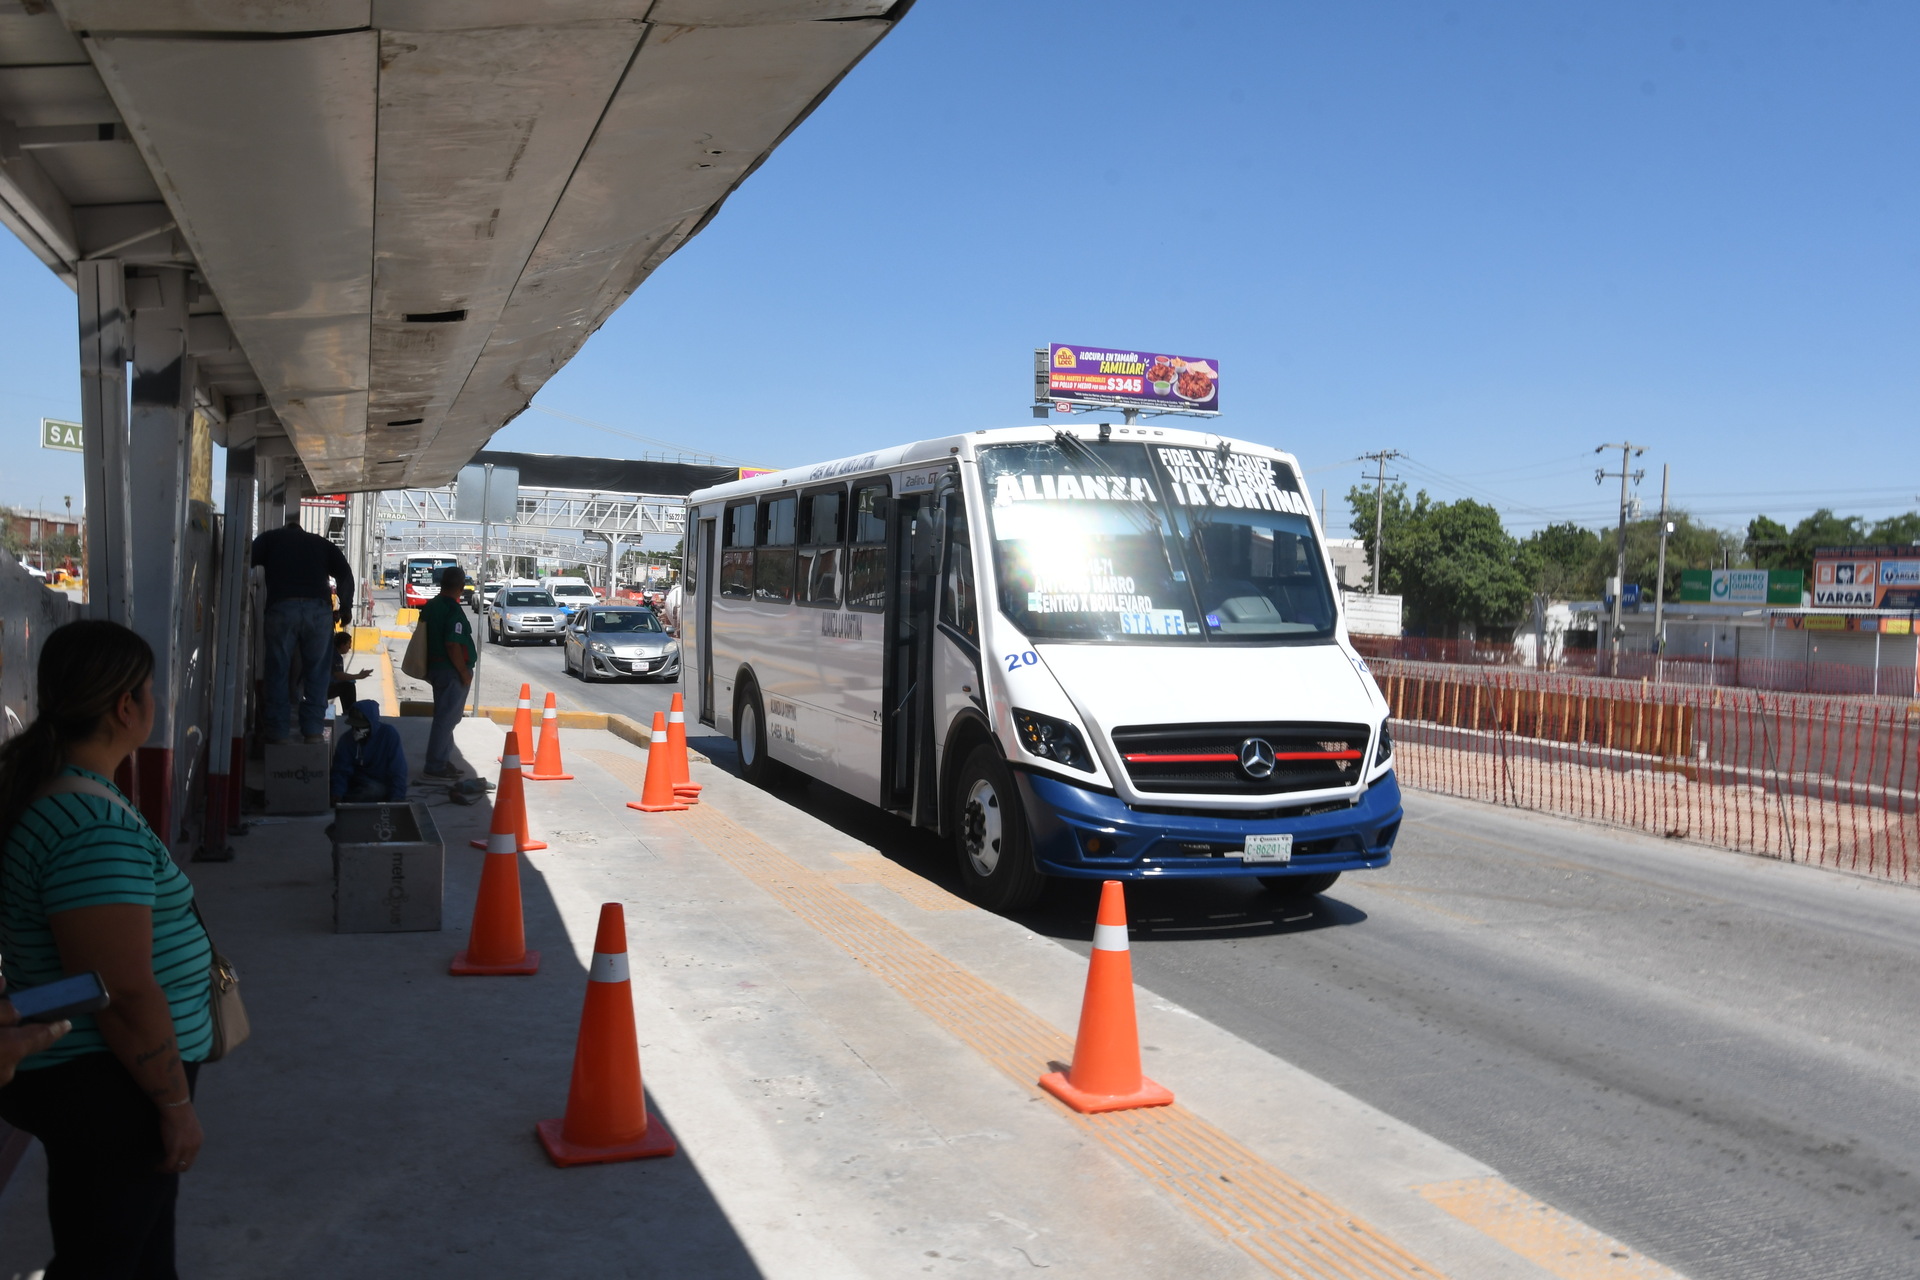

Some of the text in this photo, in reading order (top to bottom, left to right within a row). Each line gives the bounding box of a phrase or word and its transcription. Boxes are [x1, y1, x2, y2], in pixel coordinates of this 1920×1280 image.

[1079, 351, 1138, 363] ¡LOCURA EN TAMAÑO
[1099, 361, 1146, 375] FAMILIAR!
[1107, 377, 1142, 392] $345
[1157, 447, 1277, 476] FIDEL VEAZQUEZ
[1166, 465, 1278, 491] VALLE VERDE
[993, 474, 1158, 502] ALIANZA
[1207, 484, 1310, 517] CORTINA
[377, 512, 406, 520] NTRADA
[1092, 576, 1135, 594] NARRO
[1732, 573, 1765, 582] CENTRO
[1079, 594, 1090, 612] X
[1090, 593, 1153, 614] BOULEVARD
[1816, 591, 1872, 603] VARGAS
[1164, 615, 1183, 635] FE
[1004, 651, 1038, 672] 20
